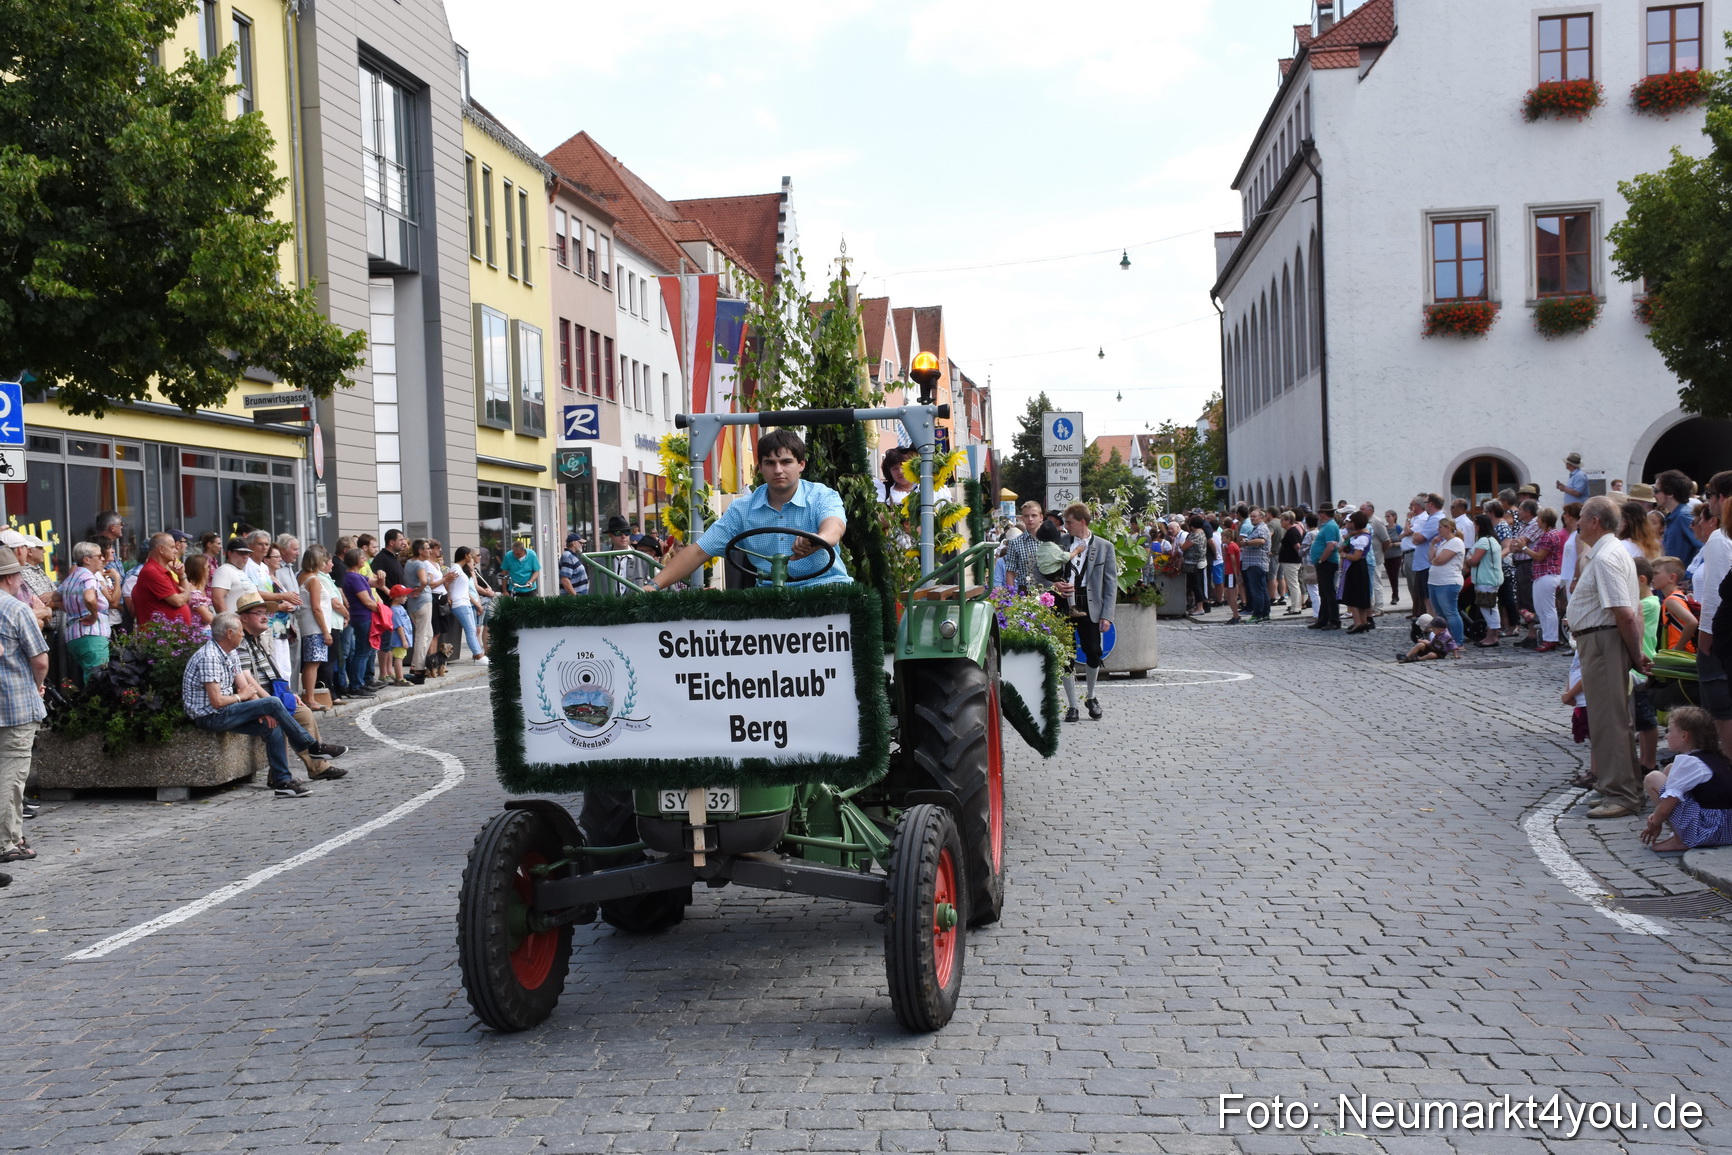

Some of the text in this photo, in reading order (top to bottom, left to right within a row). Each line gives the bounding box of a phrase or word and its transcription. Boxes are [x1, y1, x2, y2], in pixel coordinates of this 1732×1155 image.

[245, 393, 307, 406] Brunnwirtsgasse
[1053, 444, 1074, 452] ZONE
[658, 624, 850, 659] Schützenverein
[576, 651, 594, 660] 1926
[675, 668, 836, 701] "Eichenlaub"
[729, 714, 788, 749] Berg
[664, 792, 688, 810] SY
